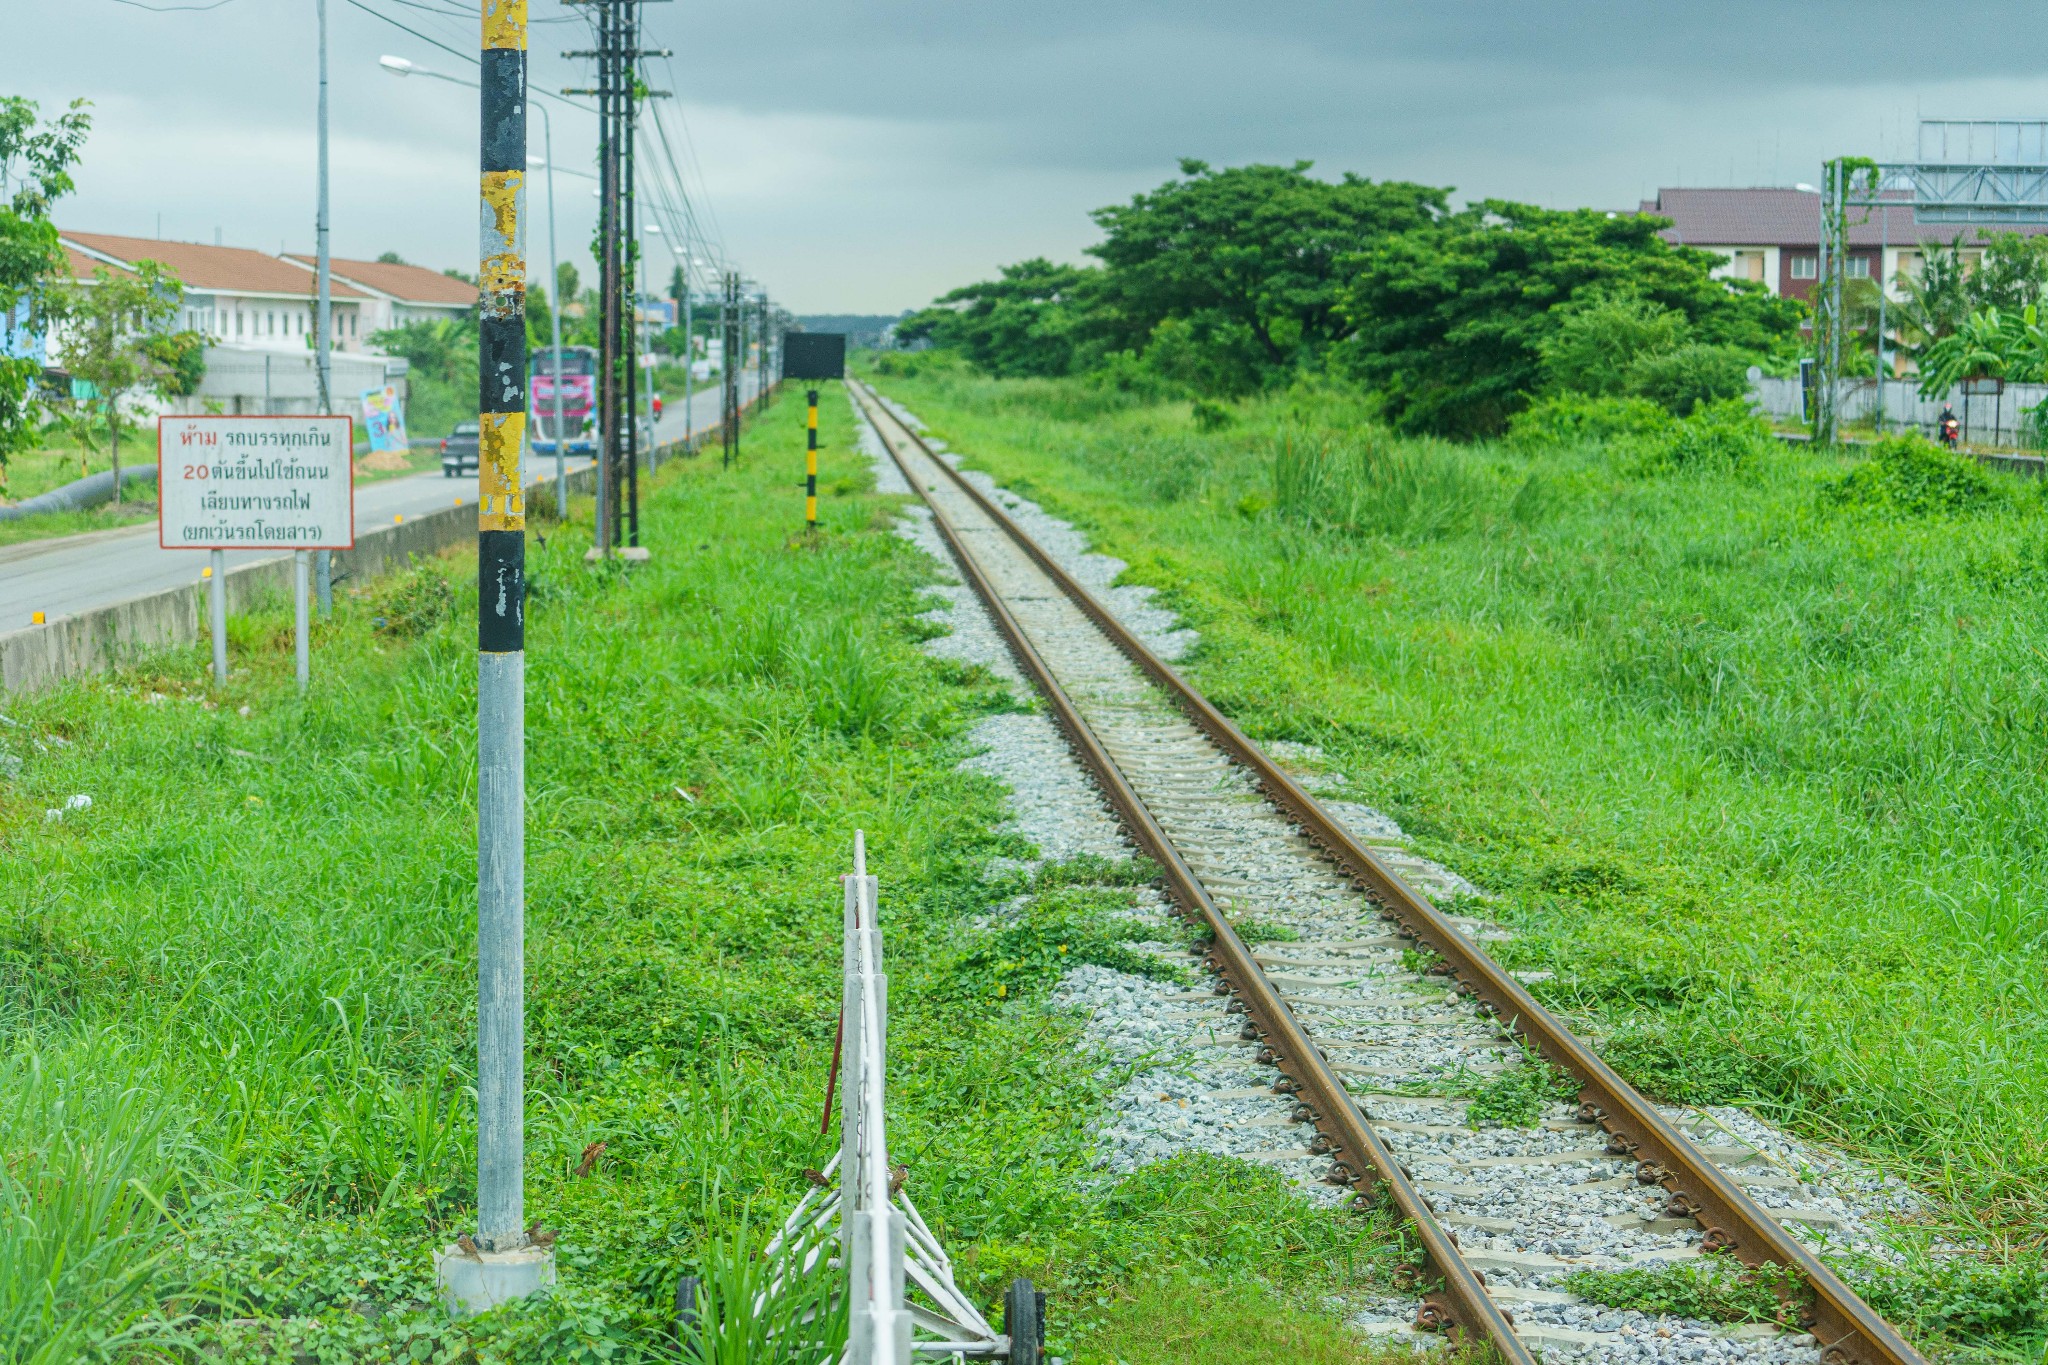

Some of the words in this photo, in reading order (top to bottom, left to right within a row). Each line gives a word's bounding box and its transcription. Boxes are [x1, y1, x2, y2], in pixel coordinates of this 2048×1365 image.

[180, 424, 217, 446] ห้าม
[225, 427, 331, 451] รถบรรทุกเกิน
[201, 488, 310, 511] เลียบทางรถไฟ
[183, 519, 322, 541] (ยกเว้นรถโดยสาร)
